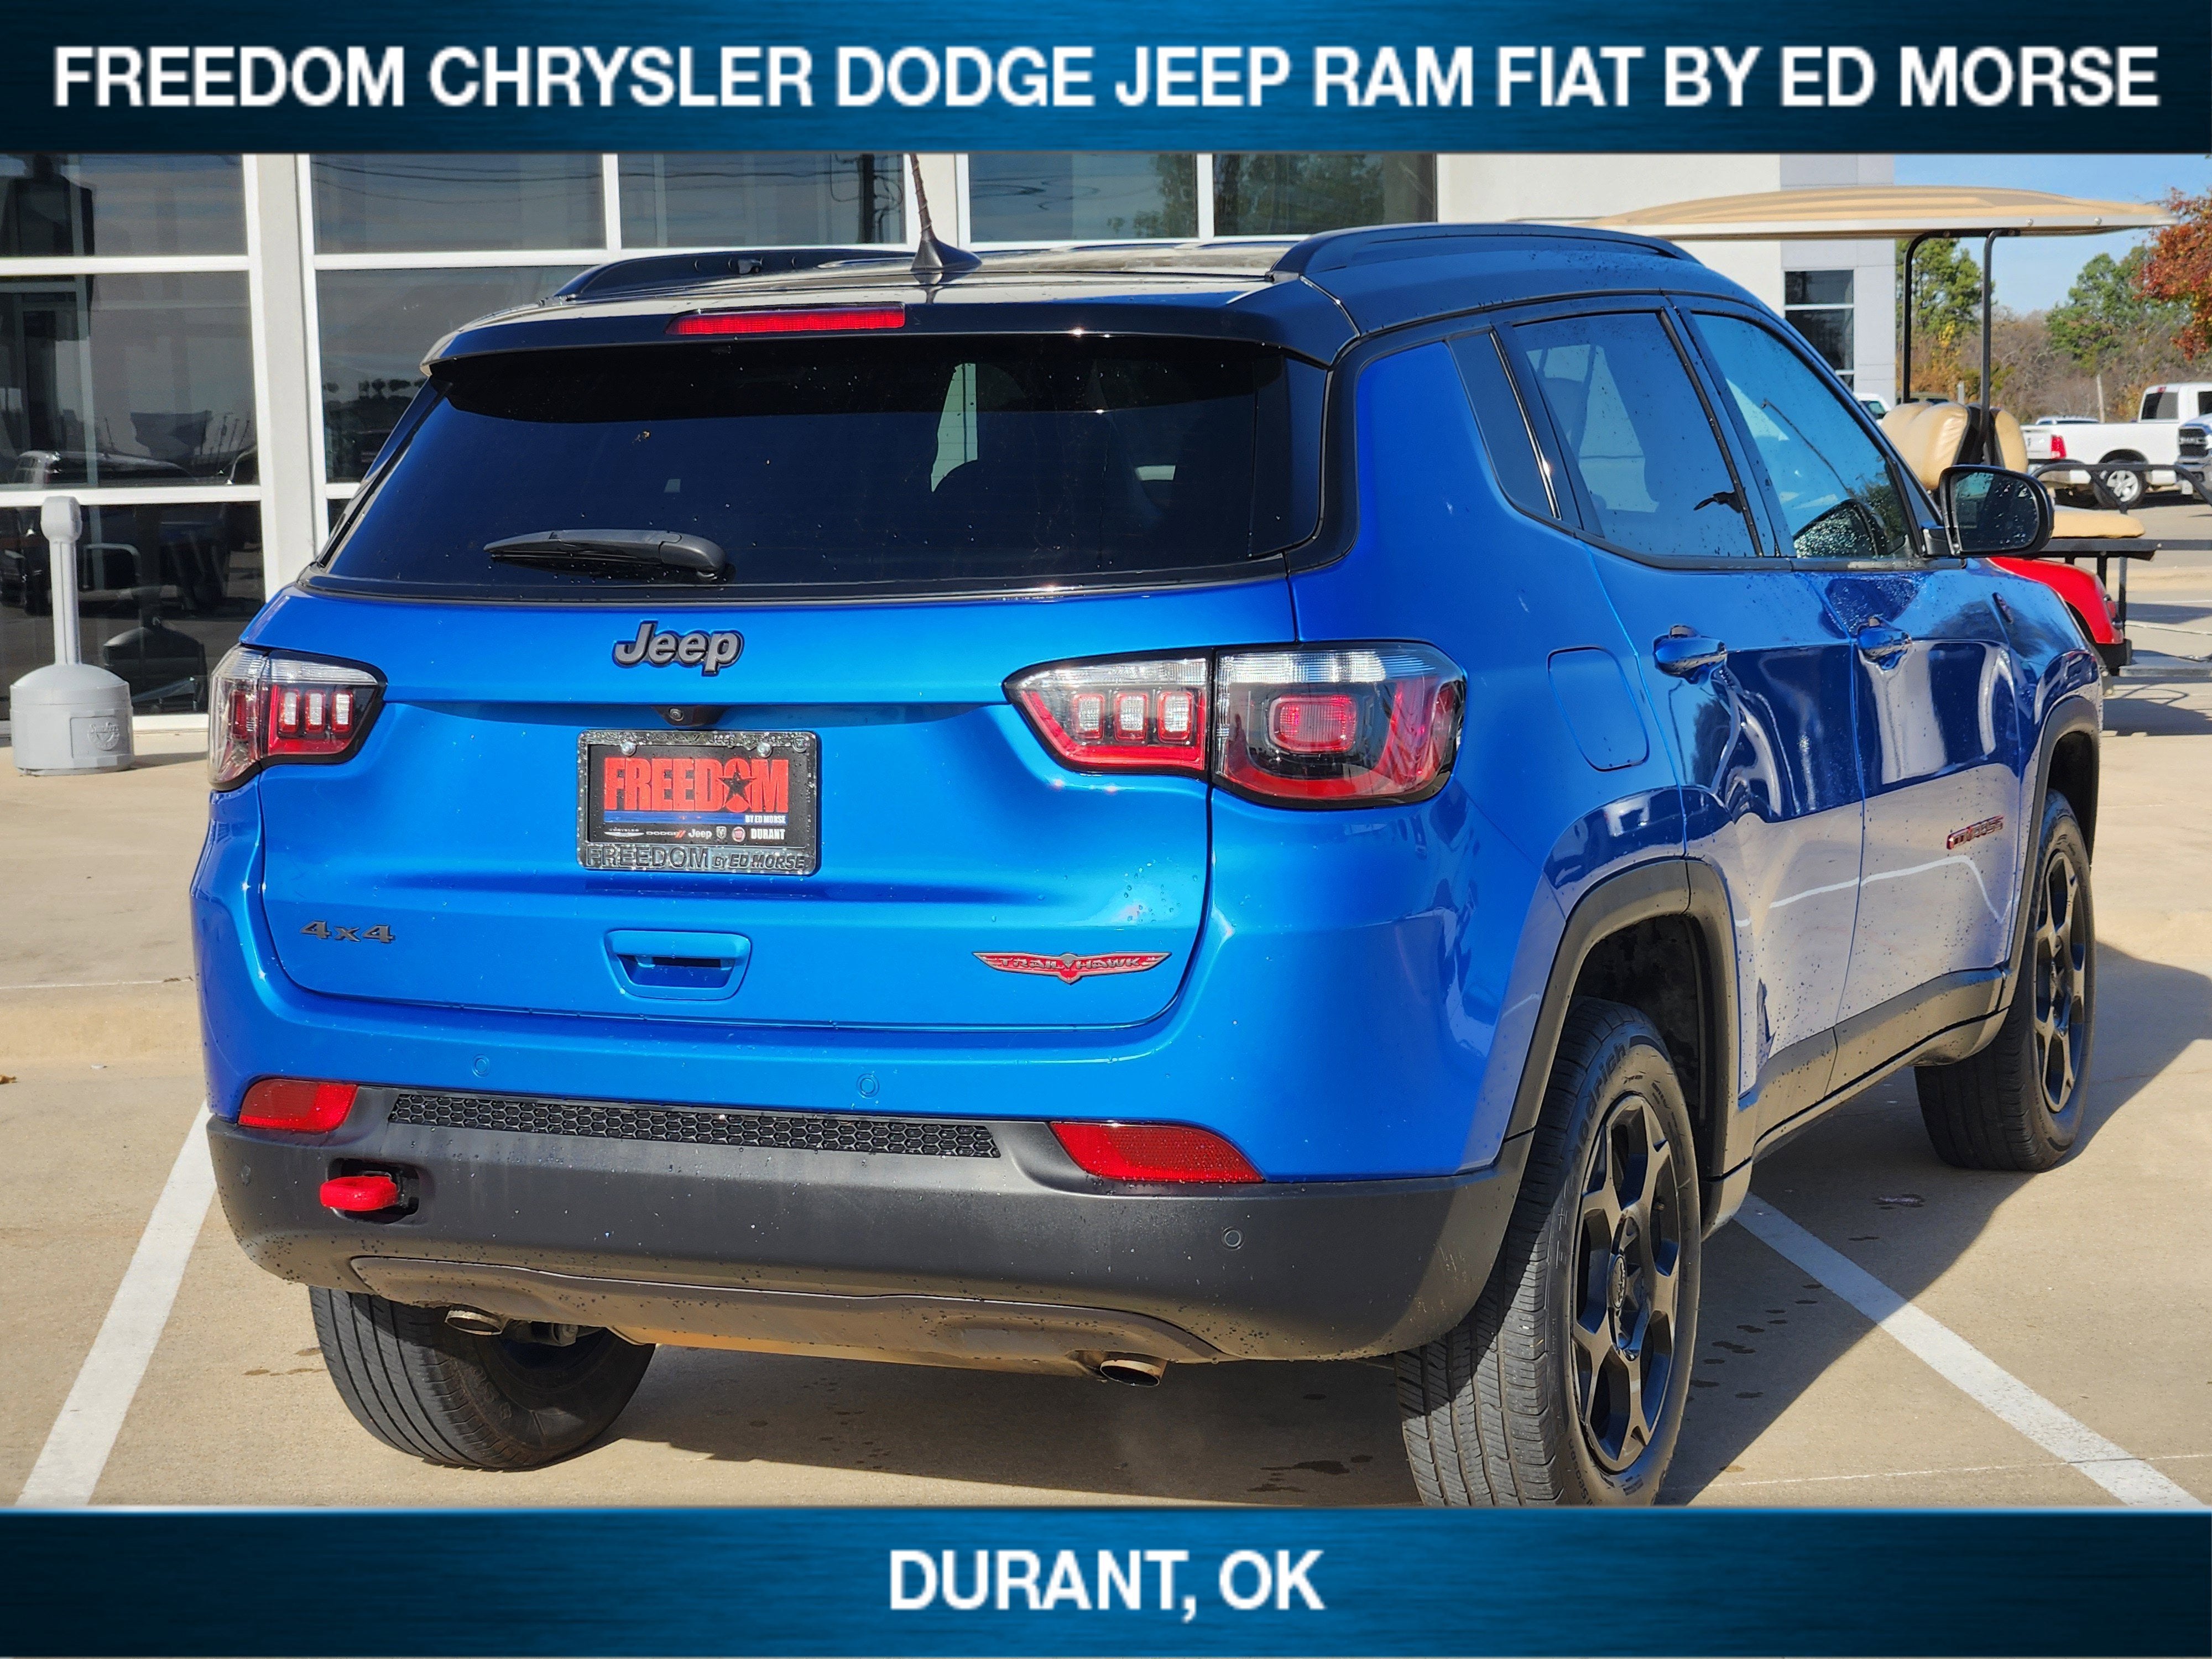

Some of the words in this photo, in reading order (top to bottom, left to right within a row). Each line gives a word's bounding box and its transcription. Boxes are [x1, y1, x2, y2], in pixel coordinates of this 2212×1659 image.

[614, 621, 743, 675] Jeep
[604, 757, 789, 813] FREEDOM
[745, 815, 754, 823] BY
[754, 815, 763, 823] ED
[763, 815, 786, 824] MORSE
[688, 828, 713, 840] Jeep
[750, 828, 786, 840] DURANT
[586, 846, 709, 869] FREEDOM
[730, 853, 749, 868] ED
[750, 854, 805, 870] MORSE
